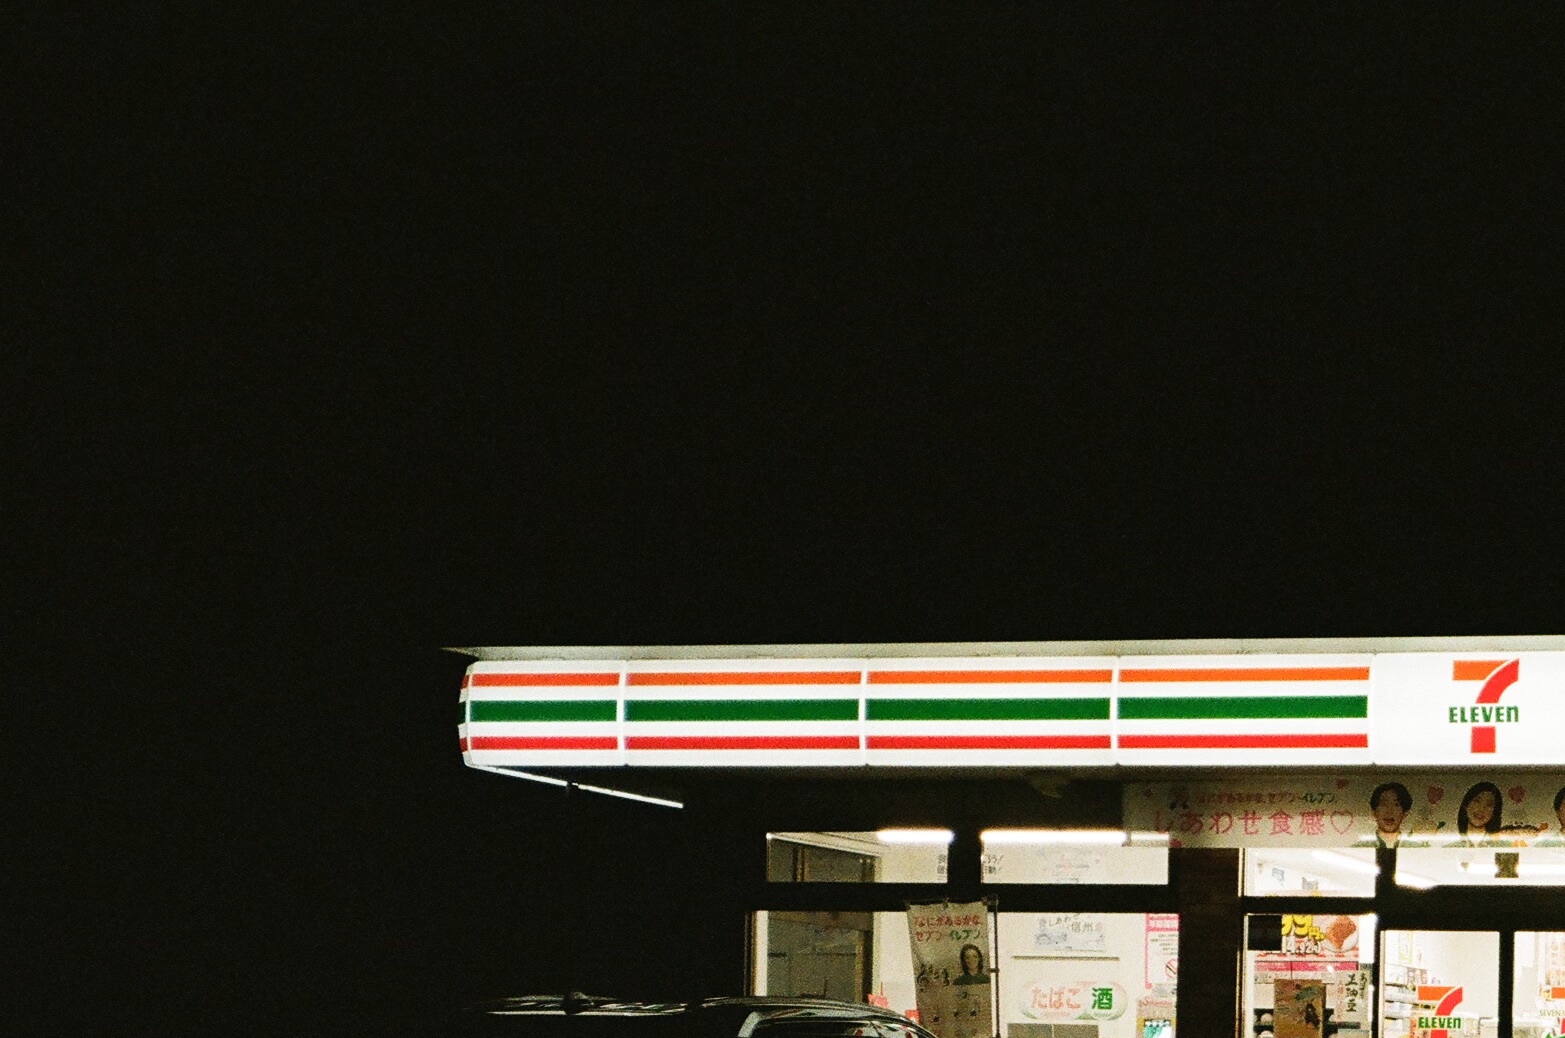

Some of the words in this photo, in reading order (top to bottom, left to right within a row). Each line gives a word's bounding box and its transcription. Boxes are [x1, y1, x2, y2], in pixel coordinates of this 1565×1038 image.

[1453, 658, 1520, 754] 7
[1031, 986, 1081, 1009] たばこ
[1091, 987, 1114, 1010] 酒
